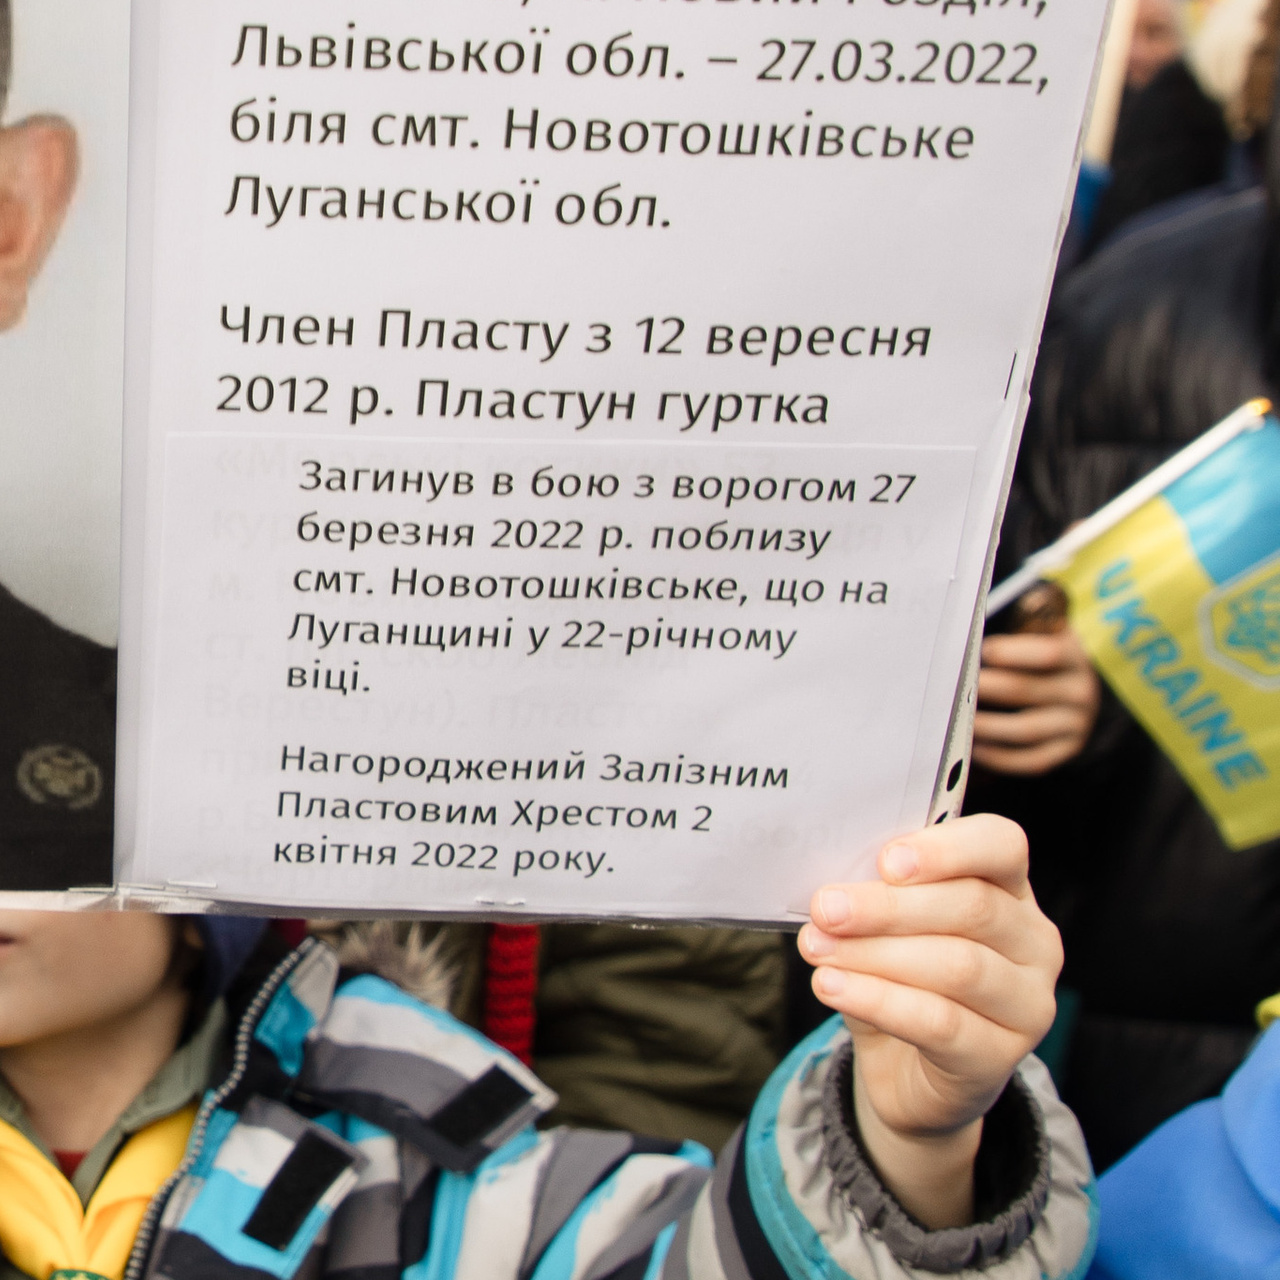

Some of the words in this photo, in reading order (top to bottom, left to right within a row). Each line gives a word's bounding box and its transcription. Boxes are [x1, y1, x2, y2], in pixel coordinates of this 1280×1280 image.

[231, 22, 551, 75] Львівської
[566, 31, 685, 80] обл.
[756, 39, 1049, 95] 27.03.2022,
[230, 96, 346, 145] біля
[371, 113, 479, 149] смт.
[504, 108, 974, 160] Новотошківське
[224, 175, 540, 228] Луганської
[555, 183, 670, 228] обл.
[220, 305, 354, 347] Член
[379, 309, 570, 363] Пласту
[585, 323, 612, 354] з
[636, 316, 685, 355] 12
[706, 325, 932, 367] вересня
[216, 374, 329, 414] 2012
[350, 386, 393, 426] р.
[416, 379, 636, 431] Пластун
[657, 392, 829, 433] гуртка
[299, 460, 474, 503] Загинув
[492, 472, 514, 496] в
[531, 465, 620, 498] бою
[633, 474, 655, 498] з
[672, 475, 856, 509] ворогом
[869, 473, 917, 504] 27
[297, 511, 475, 552] березня
[490, 519, 584, 549] 2022
[598, 526, 633, 557] р.
[651, 519, 832, 560] поблизу
[293, 569, 374, 595] смт.
[391, 567, 748, 607] Новотошківське,
[765, 579, 825, 608] що
[839, 581, 888, 604] на
[288, 613, 513, 653] Луганщині
[527, 626, 550, 656] у
[561, 617, 797, 660] 22-річному
[287, 659, 370, 696] віці.
[1094, 558, 1268, 790] UKRAINE
[281, 745, 585, 785] Нагороджений
[599, 753, 788, 789] Залізним
[277, 791, 497, 826] Пластовим
[510, 799, 677, 833] Хрестом
[691, 805, 713, 832] 2
[274, 834, 397, 866] квітня
[411, 841, 498, 870] 2022
[512, 849, 614, 879] року.
